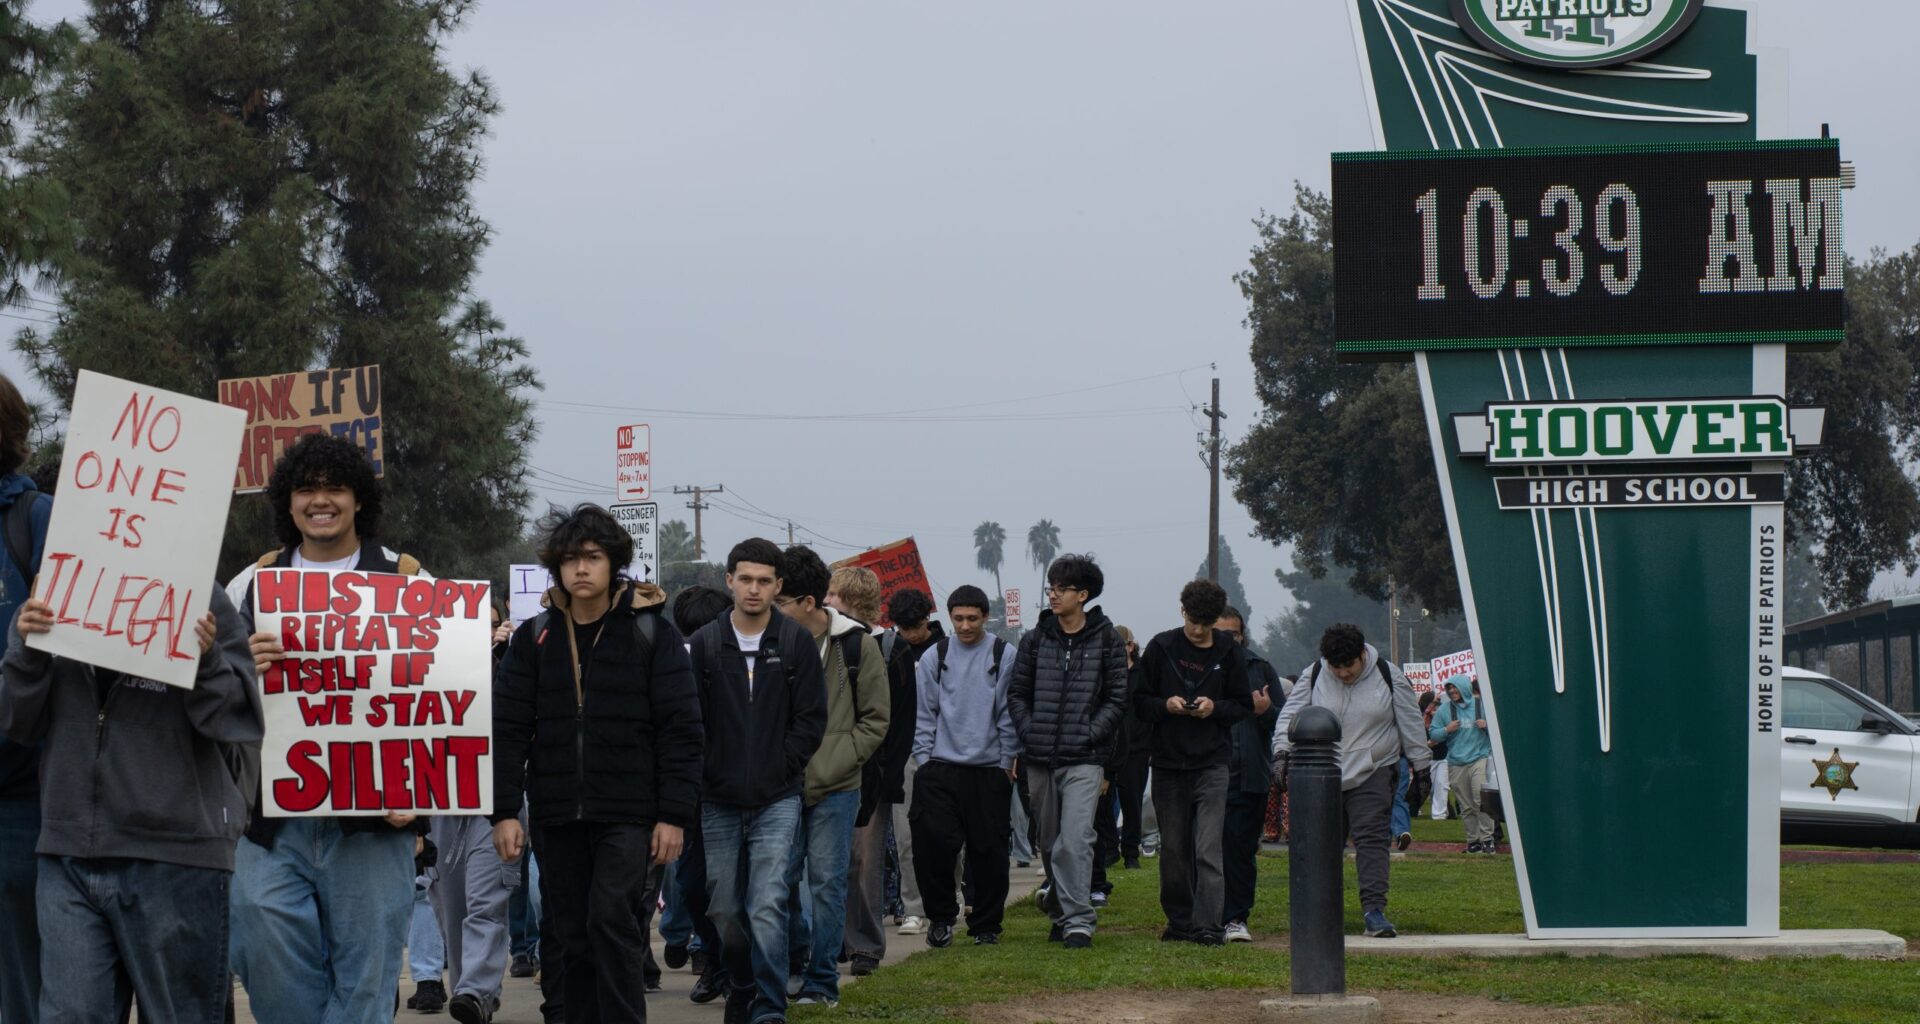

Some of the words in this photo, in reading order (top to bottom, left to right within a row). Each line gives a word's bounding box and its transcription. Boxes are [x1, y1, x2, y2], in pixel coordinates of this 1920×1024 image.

[1415, 183, 1641, 300] 10:39
[1699, 178, 1843, 294] AM
[221, 374, 300, 425] HONK
[308, 370, 351, 416] IF
[355, 366, 379, 415] U
[112, 392, 181, 452] NO
[1493, 403, 1788, 458] HOOVER
[75, 451, 186, 504] ONE
[618, 451, 649, 468] STOPPING
[1529, 479, 1608, 503] HIGH
[1625, 477, 1757, 501] SCHOOL
[99, 508, 146, 548] IS
[611, 507, 655, 520] PASSENGER
[622, 522, 650, 535] ADING
[632, 537, 643, 550] NE
[1760, 525, 1775, 608] PATRIOTS
[43, 552, 195, 661] ILLEGAL
[257, 570, 490, 619] HISTORY
[281, 614, 442, 652] REPEATS
[1759, 614, 1774, 648] THE
[263, 655, 377, 695] ITSELF
[391, 652, 435, 688] IF
[1434, 651, 1473, 671] DEPOR
[1437, 663, 1475, 682] WHIT
[1759, 654, 1773, 676] OF
[126, 677, 168, 692] LIFORNIA
[1412, 683, 1432, 693] EEDS
[297, 695, 353, 727] WE
[365, 689, 477, 728] STAY
[1758, 683, 1773, 733] HOME
[272, 736, 490, 812] SILENT
